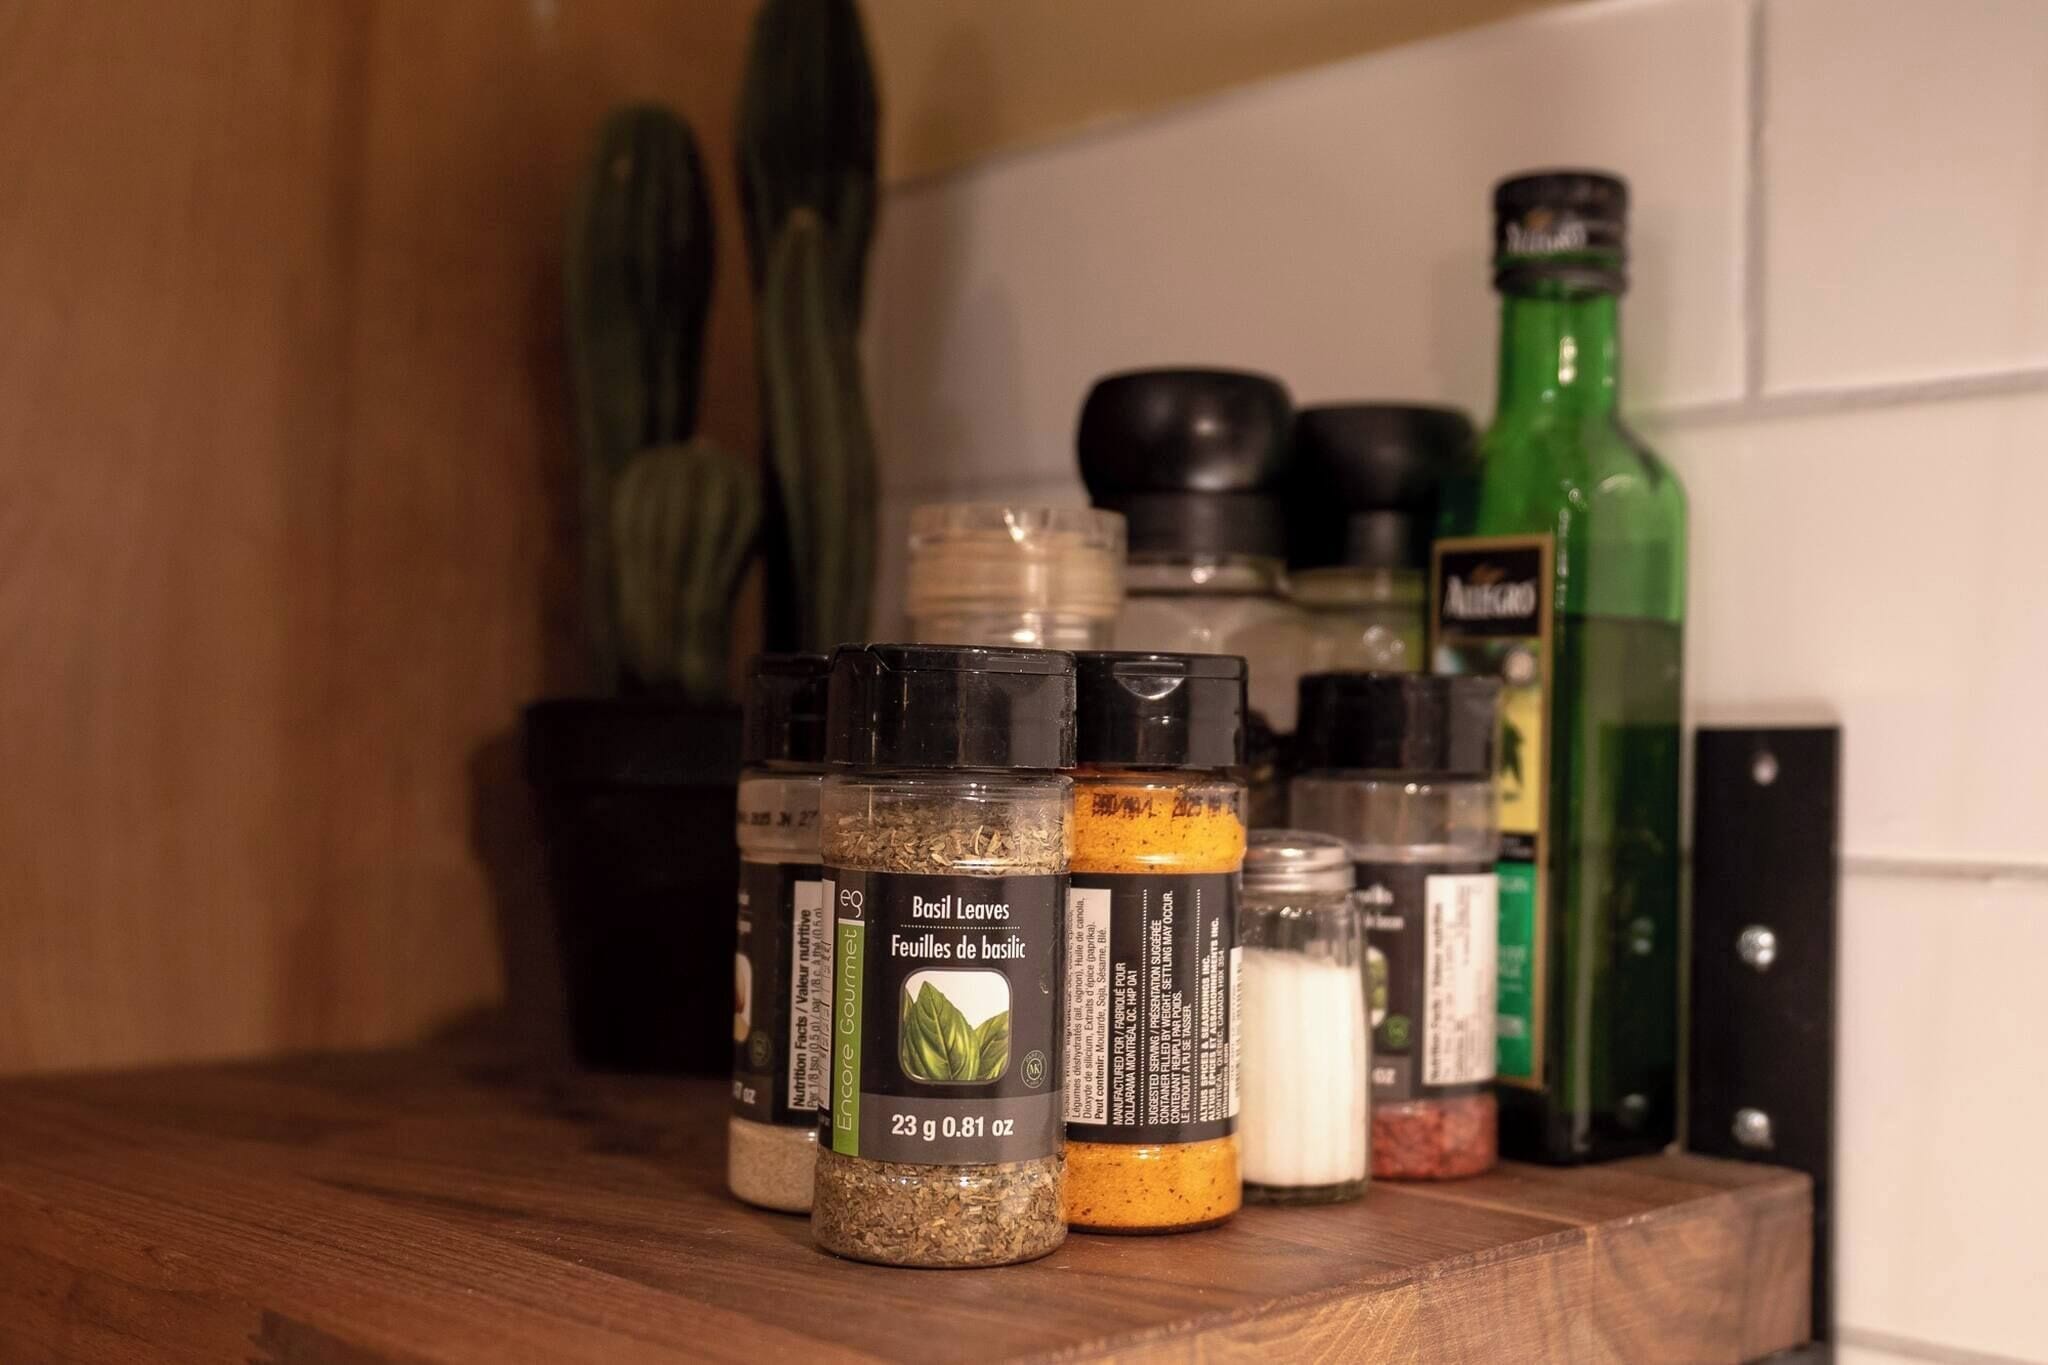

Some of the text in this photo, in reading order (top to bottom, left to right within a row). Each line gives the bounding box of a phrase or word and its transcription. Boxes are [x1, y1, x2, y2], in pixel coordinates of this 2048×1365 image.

[912, 895, 1010, 920] Basil Leaves
[1076, 897, 1085, 929] canola,
[798, 909, 811, 961] nutritive
[1075, 932, 1084, 942] de
[1150, 920, 1161, 965] SUGGÉRÉE
[1211, 917, 1219, 938] INC.
[892, 934, 1026, 960] Feuilles de basilic
[1074, 944, 1083, 966] Huile
[1097, 946, 1107, 983] Sésame,
[1115, 963, 1126, 986] POUR
[1202, 955, 1210, 975] INC.
[796, 964, 809, 1004] Valeur
[1097, 986, 1107, 1006] Soja,
[1127, 988, 1137, 1005] H4P
[1148, 967, 1160, 1028] PRÉSENTATION
[1210, 940, 1218, 1034] ASSAISONNEMENTS
[1085, 998, 1094, 1030] Extraits
[1113, 989, 1125, 1029] FABRIQUÉ
[1160, 891, 1173, 1124] CONTAINER FILLED BY WEIGHT. SETTLING MAY OCCUR.
[1183, 1003, 1191, 1038] TASSER.
[1201, 978, 1209, 1039] SEASONINGS
[795, 1016, 807, 1049] Facts
[836, 929, 857, 1130] Encore Gourmet
[1096, 1009, 1106, 1053] Moutarde,
[1114, 1037, 1124, 1054] FOR
[1183, 1039, 1191, 1051] SE
[1210, 1037, 1216, 1049] ET
[1072, 1024, 1083, 1076] déshydratés
[1084, 1033, 1094, 1069] silicium,
[1125, 1024, 1136, 1070] MONTRÉAL
[1150, 1036, 1159, 1072] SERVING
[1171, 990, 1182, 1124] CONTENANT REMPLI PAR POIDS.
[1182, 1053, 1191, 1064] PU
[793, 1054, 806, 1106] Nutrition
[1084, 1071, 1092, 1082] de
[1096, 1055, 1104, 1096] contenir:
[1201, 1052, 1209, 1086] SPICES
[1071, 1078, 1082, 1118] Légumes
[1083, 1085, 1093, 1119] Dioxyde
[1113, 1056, 1124, 1125] MANUFACTURED
[1125, 1072, 1135, 1125] DOLLARAMA
[1149, 1074, 1159, 1124] SUGGESTED
[1182, 1074, 1190, 1110] PRODUIT
[1200, 1089, 1208, 1122] ALTIUS
[1208, 1088, 1216, 1121] ALTIUS
[1095, 1099, 1104, 1120] Peut
[1181, 1112, 1190, 1123] LE
[892, 1114, 1014, 1142] 23 g 0.81 oz
